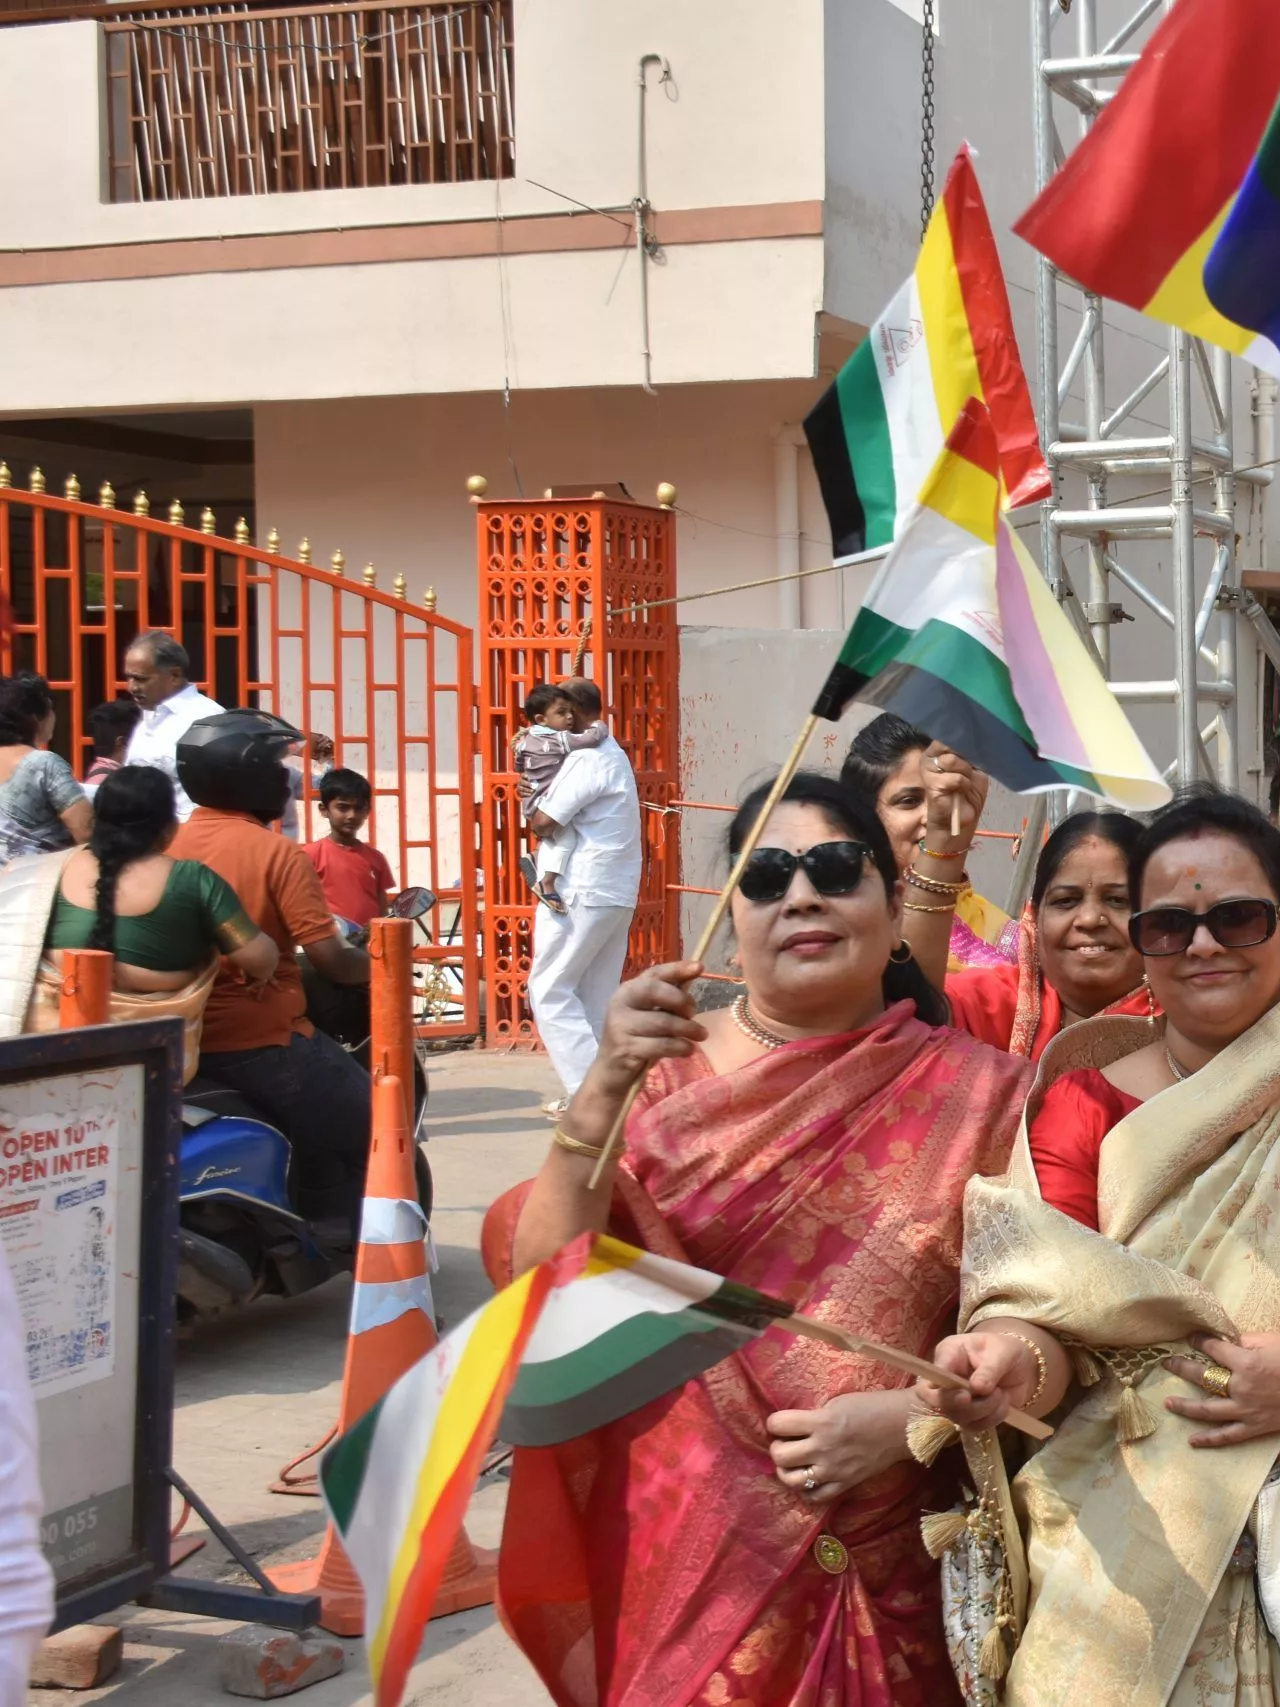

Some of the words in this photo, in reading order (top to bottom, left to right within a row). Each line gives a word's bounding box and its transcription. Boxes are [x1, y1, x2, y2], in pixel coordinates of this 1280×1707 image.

[2, 1129, 60, 1159] OPEN
[53, 1145, 109, 1176] INTER
[64, 1506, 98, 1538] 055
